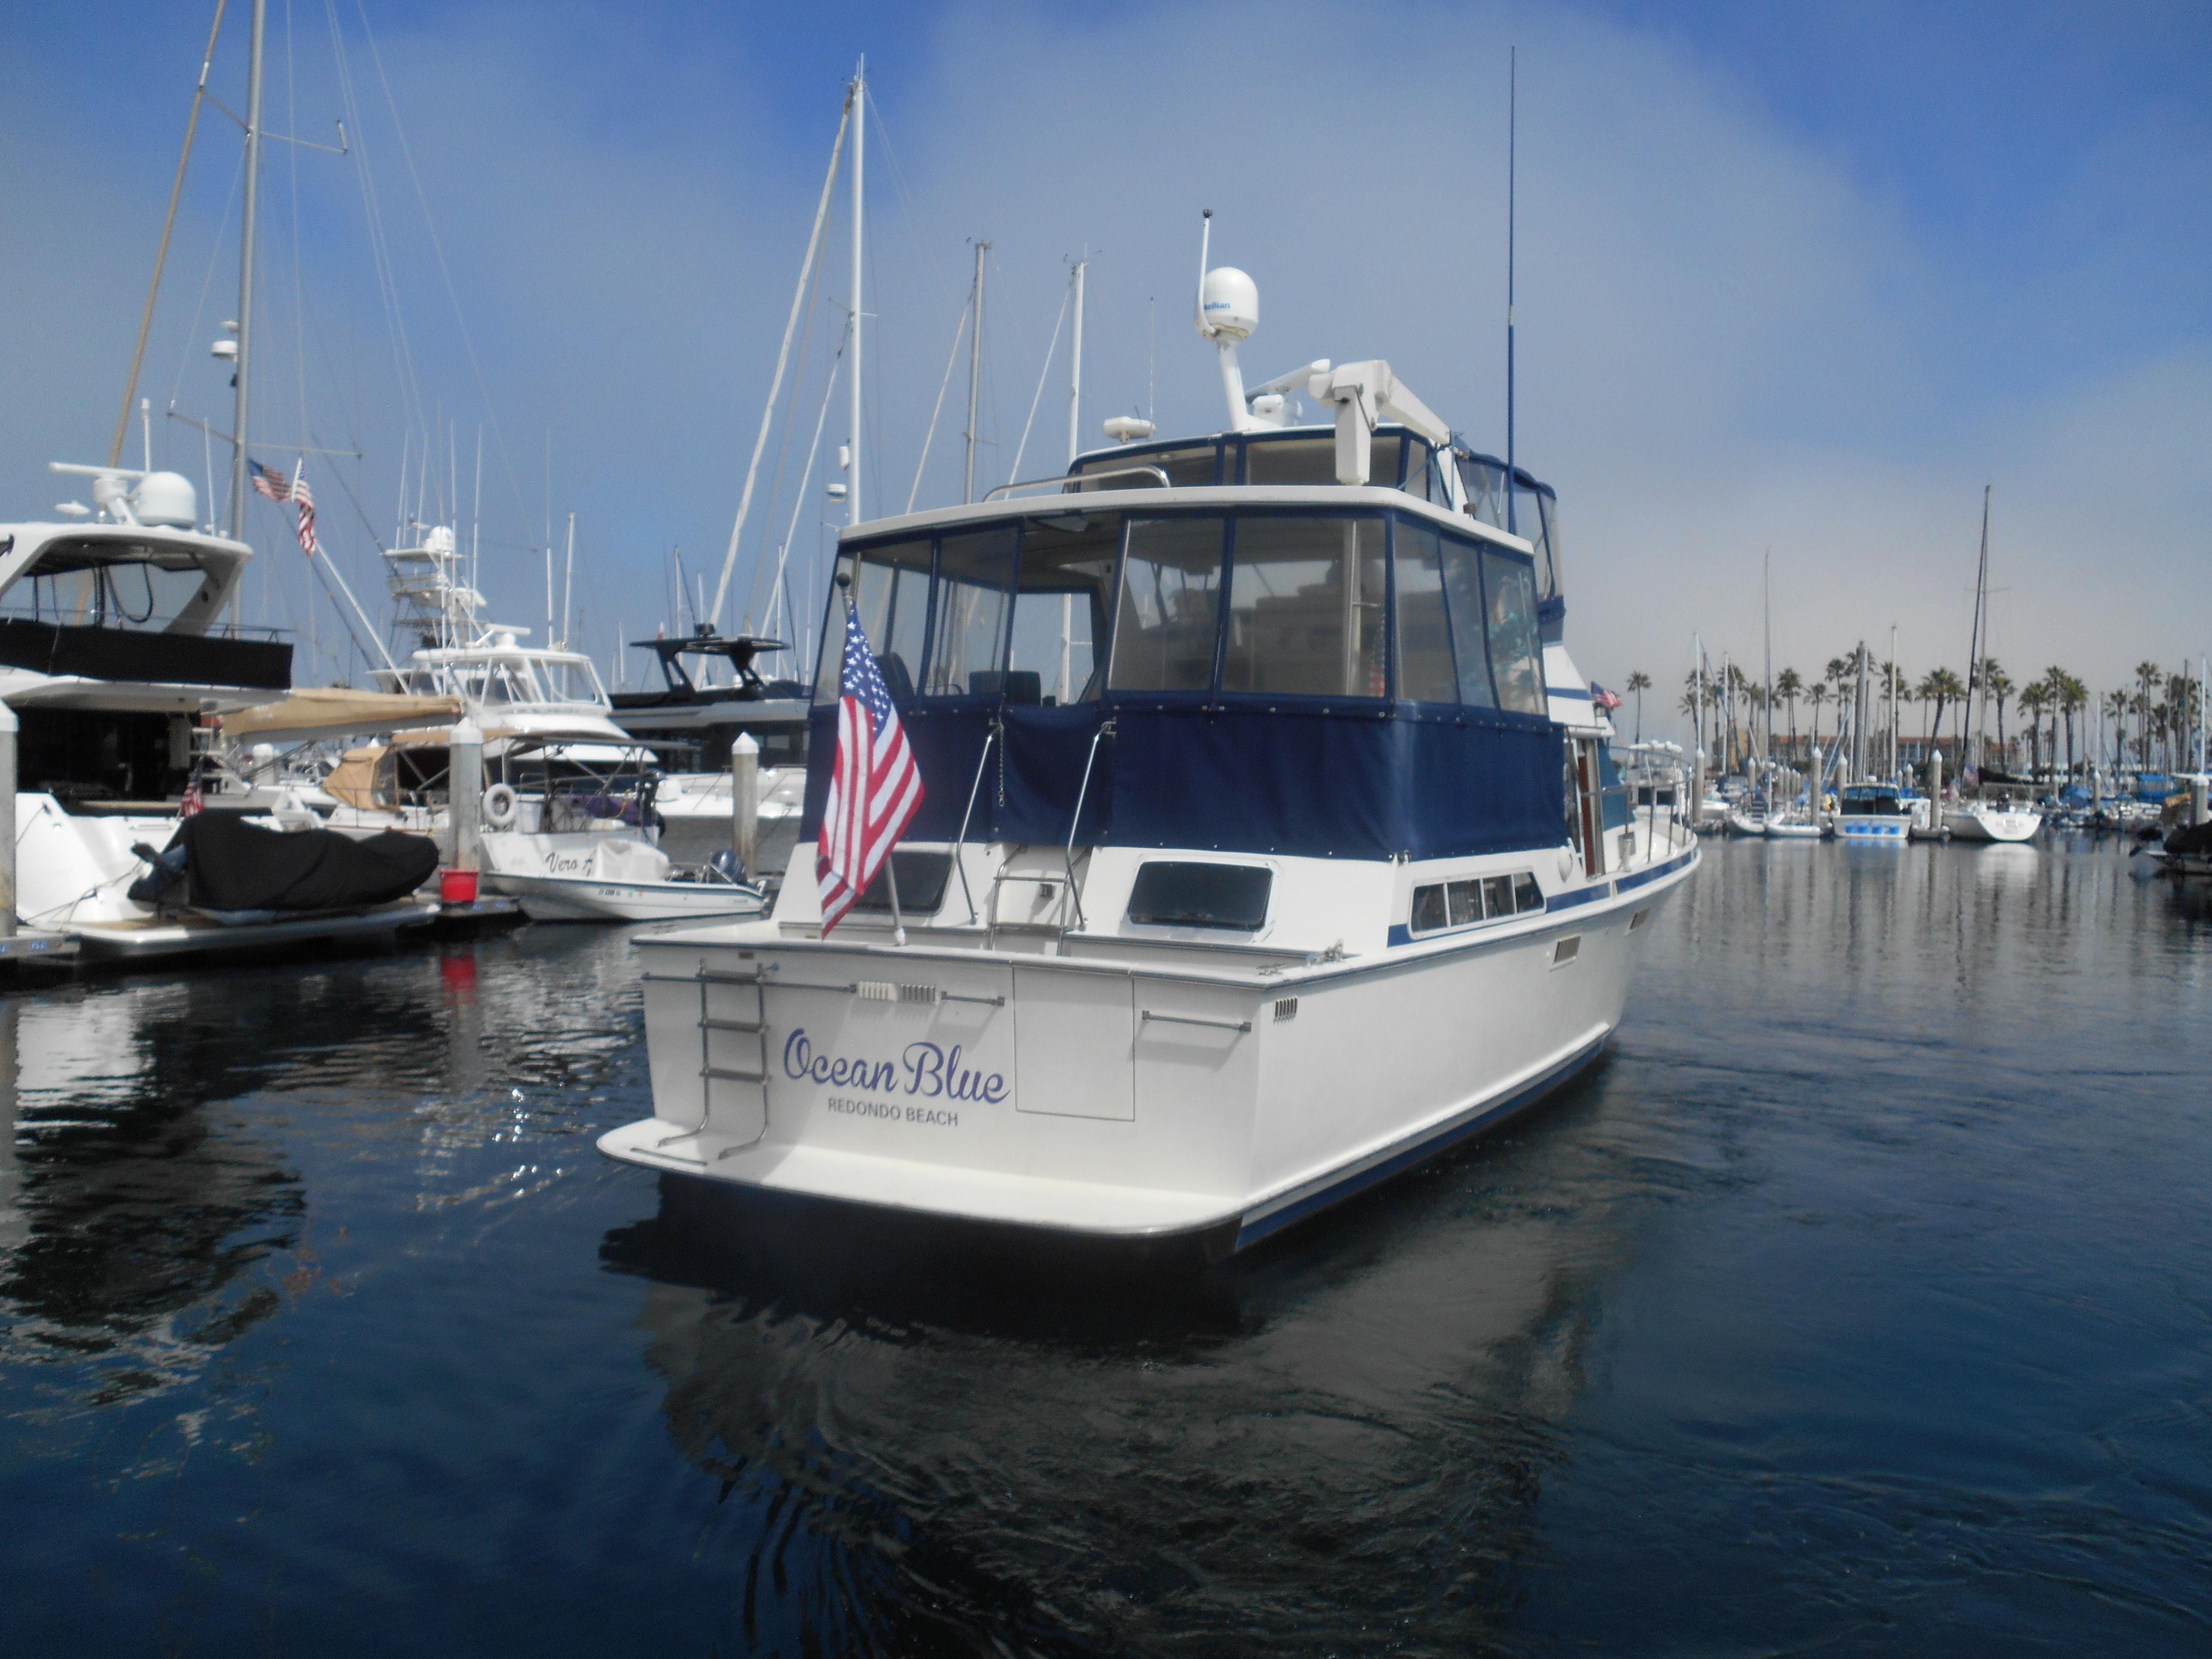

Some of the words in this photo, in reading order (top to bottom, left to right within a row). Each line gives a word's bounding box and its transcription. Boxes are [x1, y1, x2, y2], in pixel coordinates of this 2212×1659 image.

[1204, 302, 1231, 310] tellian
[545, 851, 577, 873] Vero
[783, 1027, 899, 1092] Ocean
[903, 1042, 1011, 1104] Blue
[828, 1097, 901, 1120] REDONDO
[906, 1107, 958, 1127] BEACH
